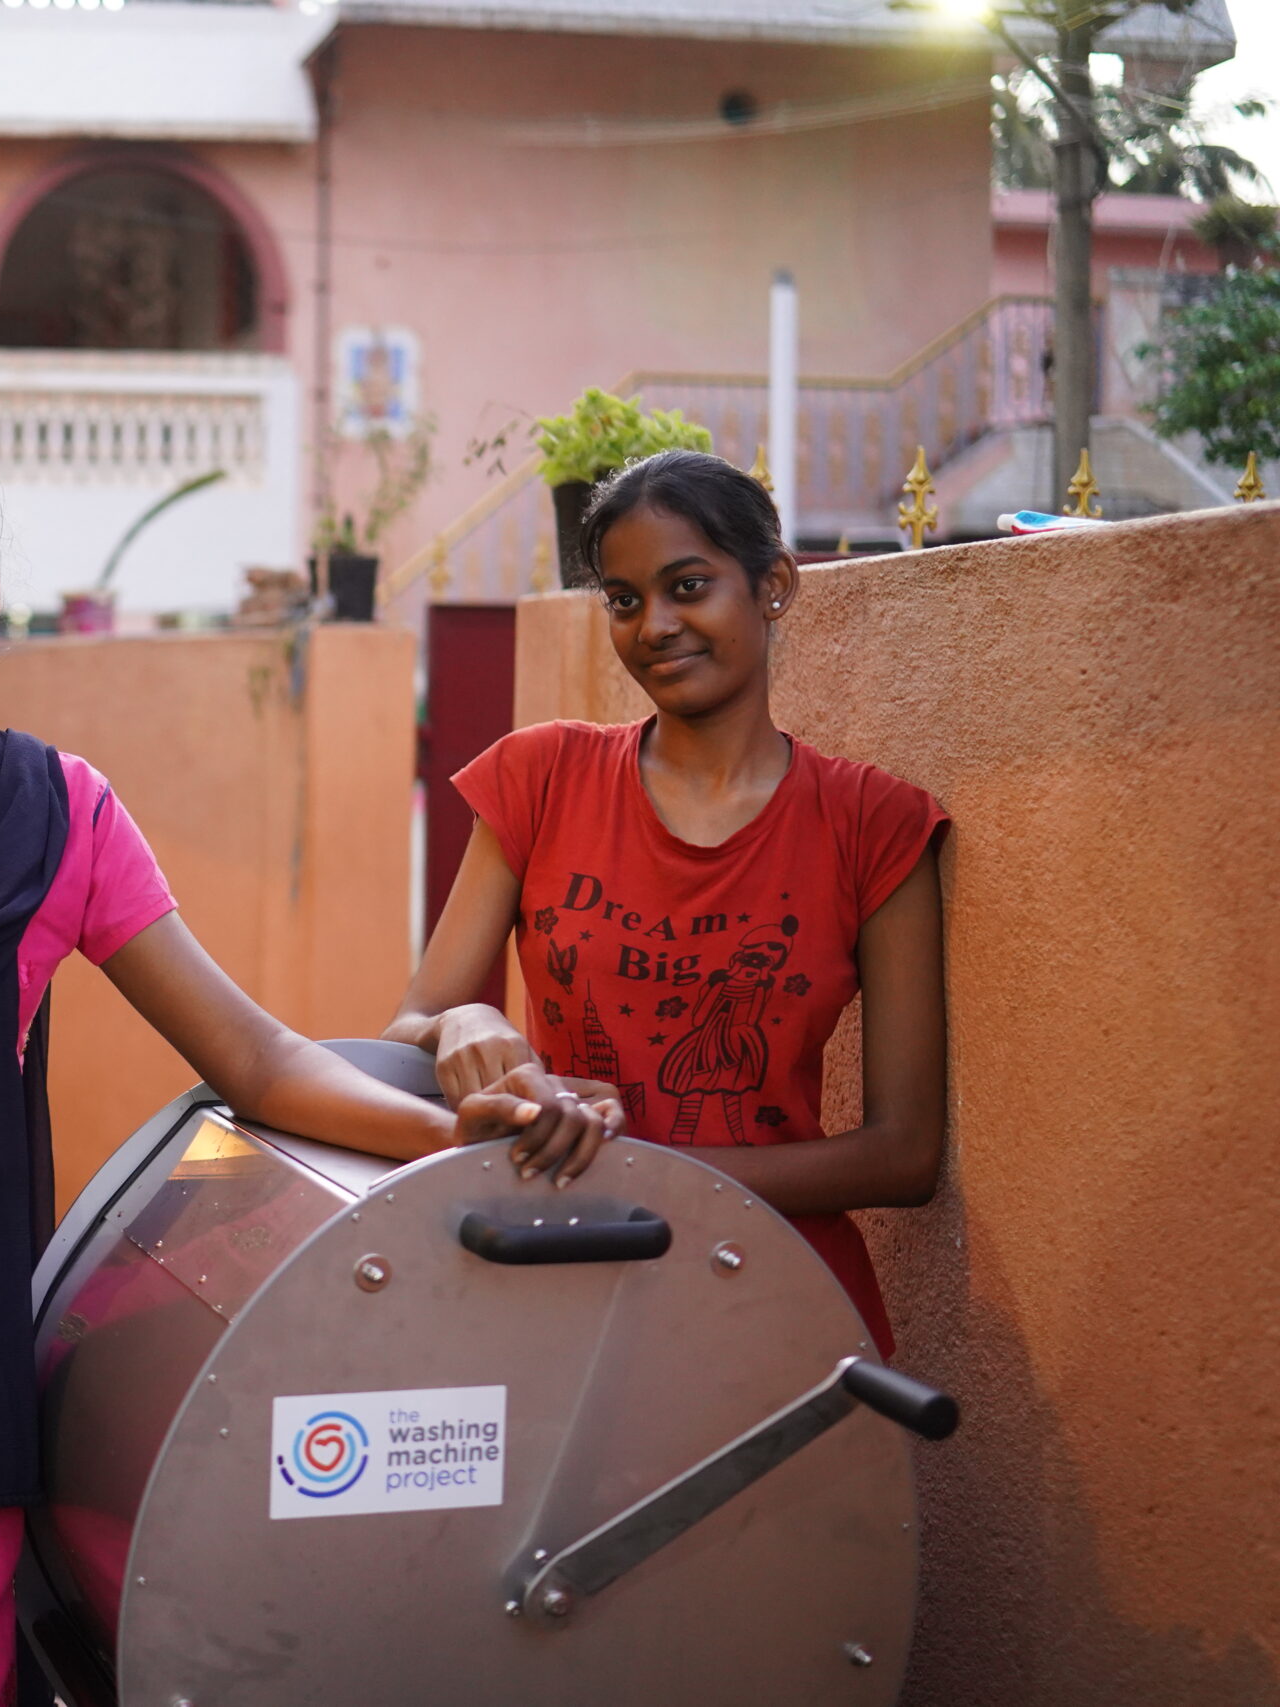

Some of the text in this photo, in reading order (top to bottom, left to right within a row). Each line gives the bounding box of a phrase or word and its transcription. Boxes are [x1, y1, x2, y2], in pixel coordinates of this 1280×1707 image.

[616, 943, 702, 987] Big
[389, 1409, 420, 1424] the
[389, 1418, 498, 1444] washing
[387, 1442, 500, 1467] machine
[386, 1465, 477, 1493] project
